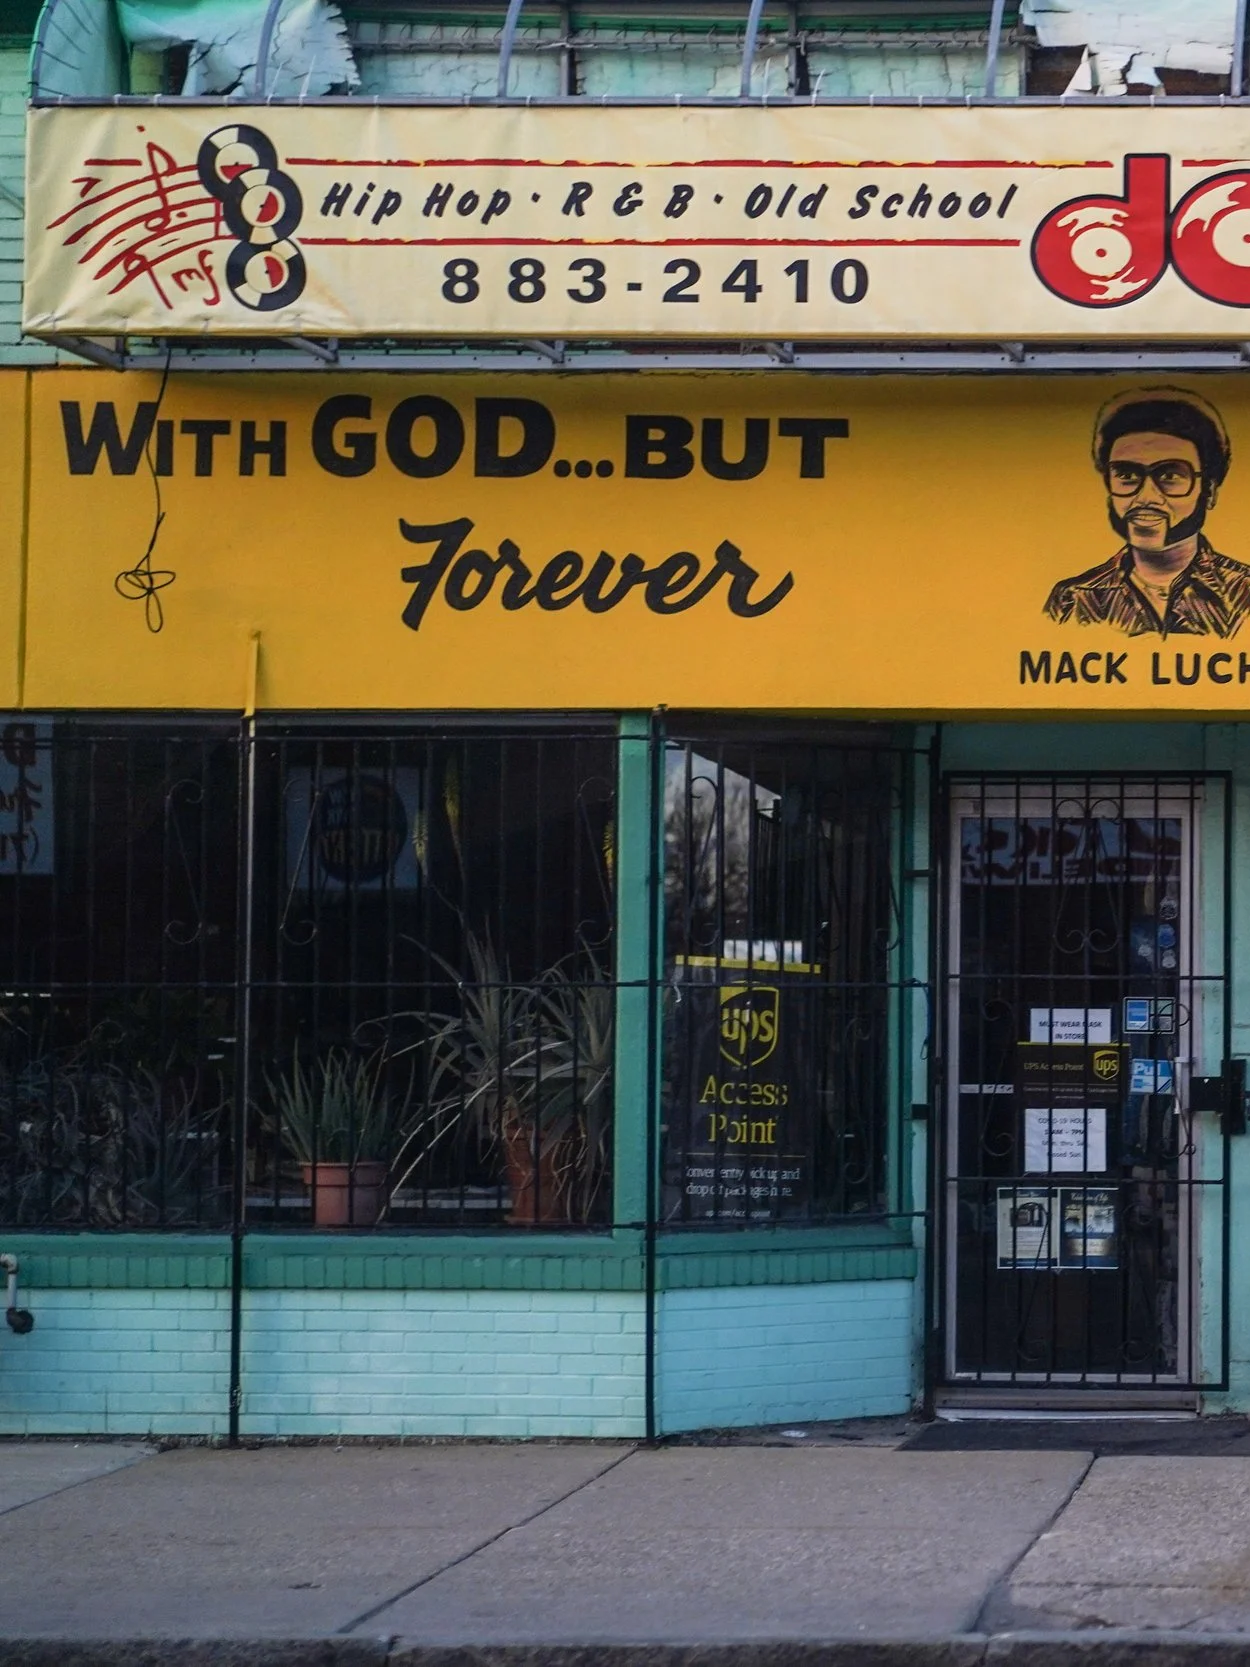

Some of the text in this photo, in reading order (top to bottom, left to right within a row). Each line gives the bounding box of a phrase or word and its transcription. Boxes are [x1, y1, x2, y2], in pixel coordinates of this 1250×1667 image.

[321, 182, 1017, 225] Hip Hop R & B Old School
[442, 257, 869, 304] 883-2410
[60, 401, 287, 477] WITH
[398, 517, 794, 632] Forever
[1020, 650, 1128, 685] MACK
[722, 1007, 774, 1054] ups
[1096, 1059, 1117, 1076] ups
